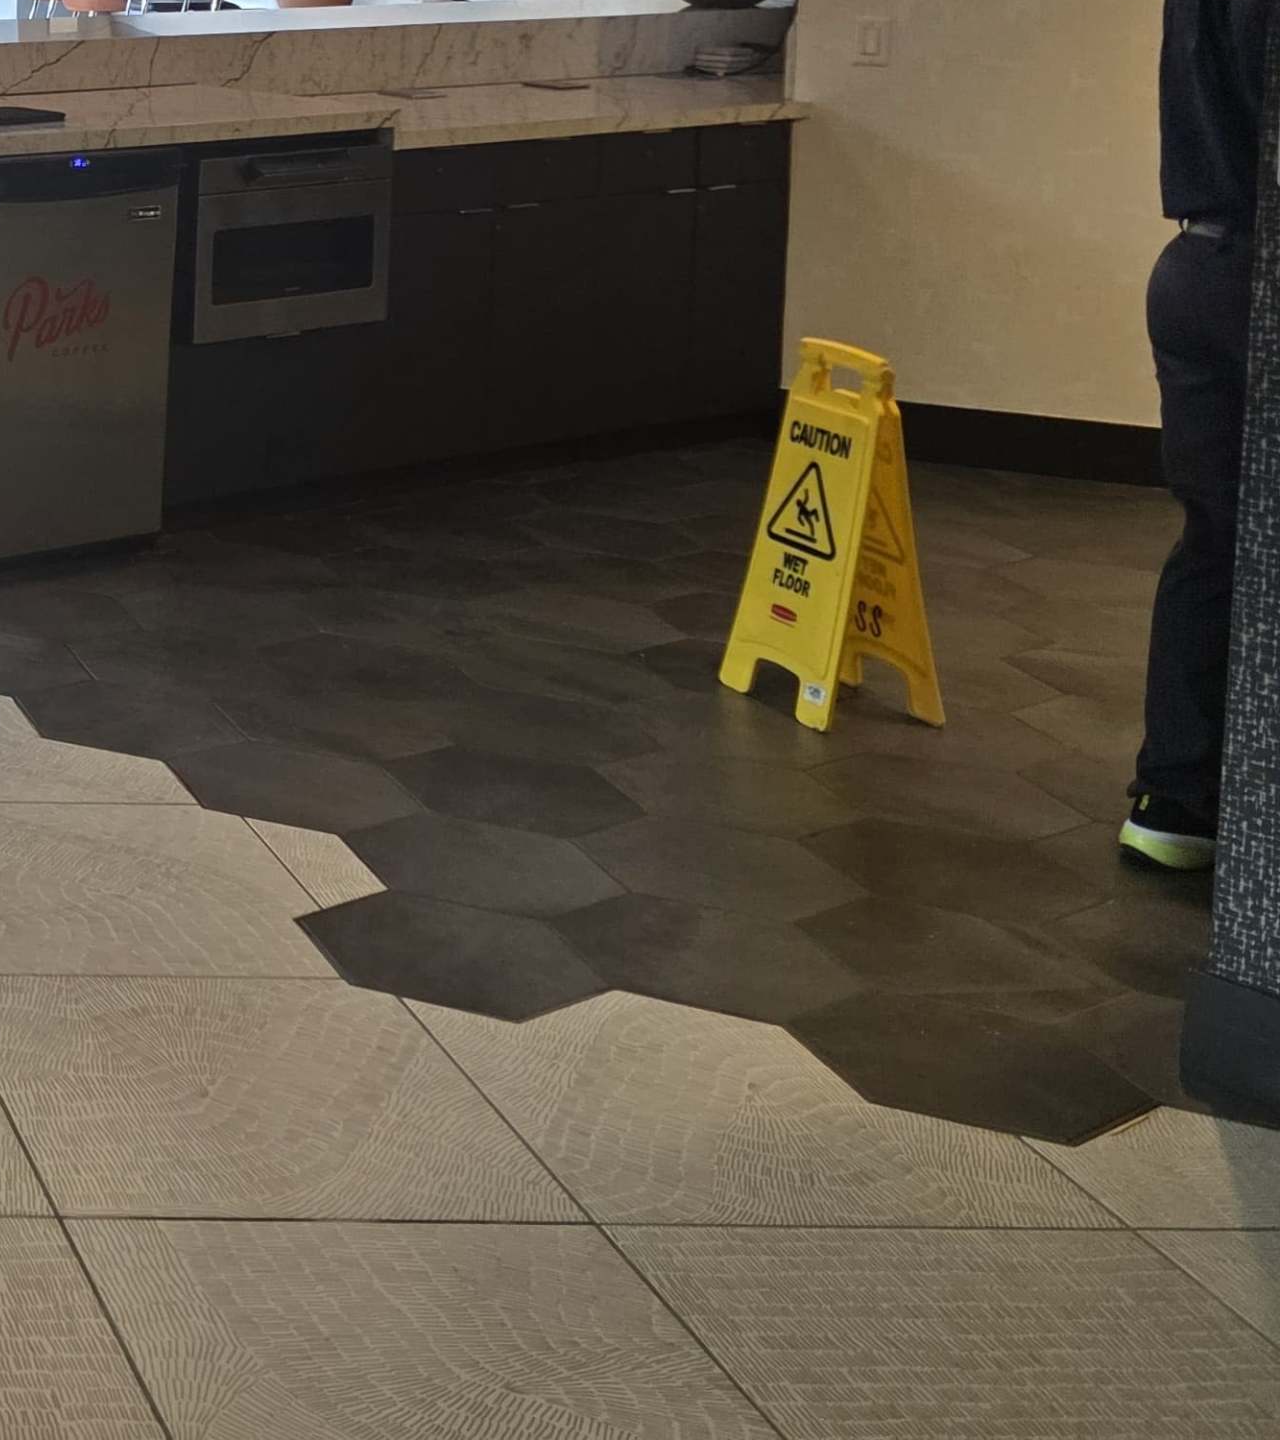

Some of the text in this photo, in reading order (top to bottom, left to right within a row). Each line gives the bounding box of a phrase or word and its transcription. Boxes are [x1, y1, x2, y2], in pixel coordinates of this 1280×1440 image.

[790, 419, 852, 460] CAUTION
[783, 551, 809, 576] WET
[773, 568, 811, 598] FLOOR
